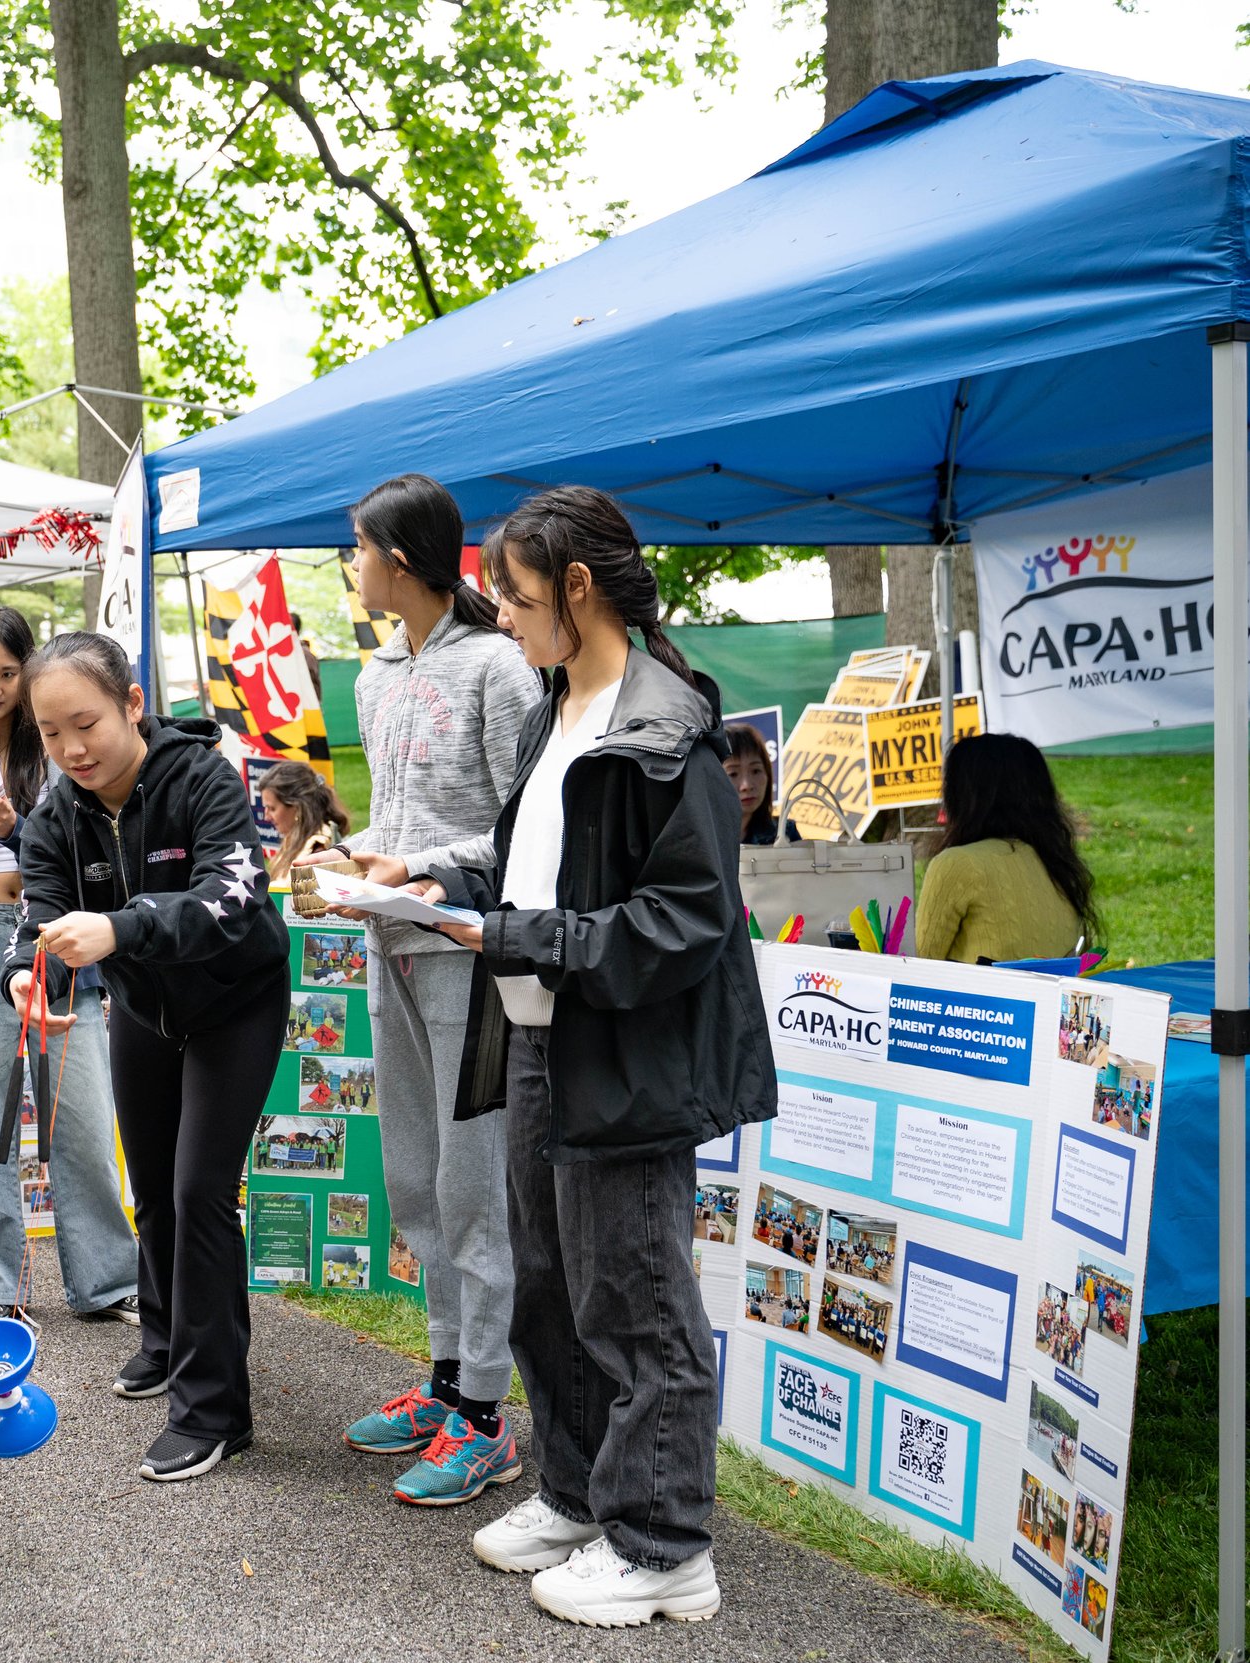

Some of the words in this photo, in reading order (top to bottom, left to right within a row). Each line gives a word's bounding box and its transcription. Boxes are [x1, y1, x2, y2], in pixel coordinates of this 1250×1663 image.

[1000, 602, 1214, 678] CAPA·H
[1069, 667, 1166, 690] MARYLAND
[897, 719, 930, 732] JOHN
[818, 731, 856, 746] JOHN
[914, 766, 941, 782] SEN
[890, 997, 942, 1015] CHINESE
[944, 1004, 1014, 1025] AMERICAN
[889, 1017, 935, 1036] PARENT
[938, 1025, 1026, 1049] ASSOCIATION
[809, 1037, 847, 1051] MARYLAND
[897, 1038, 928, 1051] HOWARD
[930, 1042, 963, 1058] COUNTY,
[964, 1050, 1008, 1065] MARYLAND
[812, 1092, 833, 1103] Vision
[813, 1116, 831, 1124] Howard
[832, 1119, 848, 1128] County
[823, 1108, 841, 1117] Howard
[842, 1112, 858, 1121] County
[939, 1117, 969, 1130] Mission
[773, 1125, 797, 1136] community
[847, 1141, 864, 1149] access
[824, 1128, 852, 1138] represented
[940, 1133, 964, 1142] empower
[992, 1143, 1001, 1151] the
[901, 1132, 921, 1142] Chinese
[933, 1140, 947, 1148] other
[948, 1144, 977, 1155] immigrants
[985, 1152, 1006, 1162] Howard
[915, 1145, 933, 1155] County
[942, 1152, 970, 1165] advocating
[895, 1160, 921, 1172] promoting
[922, 1167, 941, 1176] greater
[941, 1171, 970, 1184] community
[909, 1173, 936, 1185] supporting
[937, 1180, 964, 1191] integration
[987, 1192, 1002, 1202] larger
[923, 1275, 953, 1290] Engagement
[778, 1367, 813, 1397] FACE
[778, 1386, 791, 1402] OF
[792, 1392, 840, 1423] CHANGE
[828, 1393, 842, 1403] CFC
[779, 1413, 795, 1423] Please
[796, 1419, 815, 1432] Support
[789, 1429, 801, 1438] CFC
[619, 1565, 638, 1578] FILA
